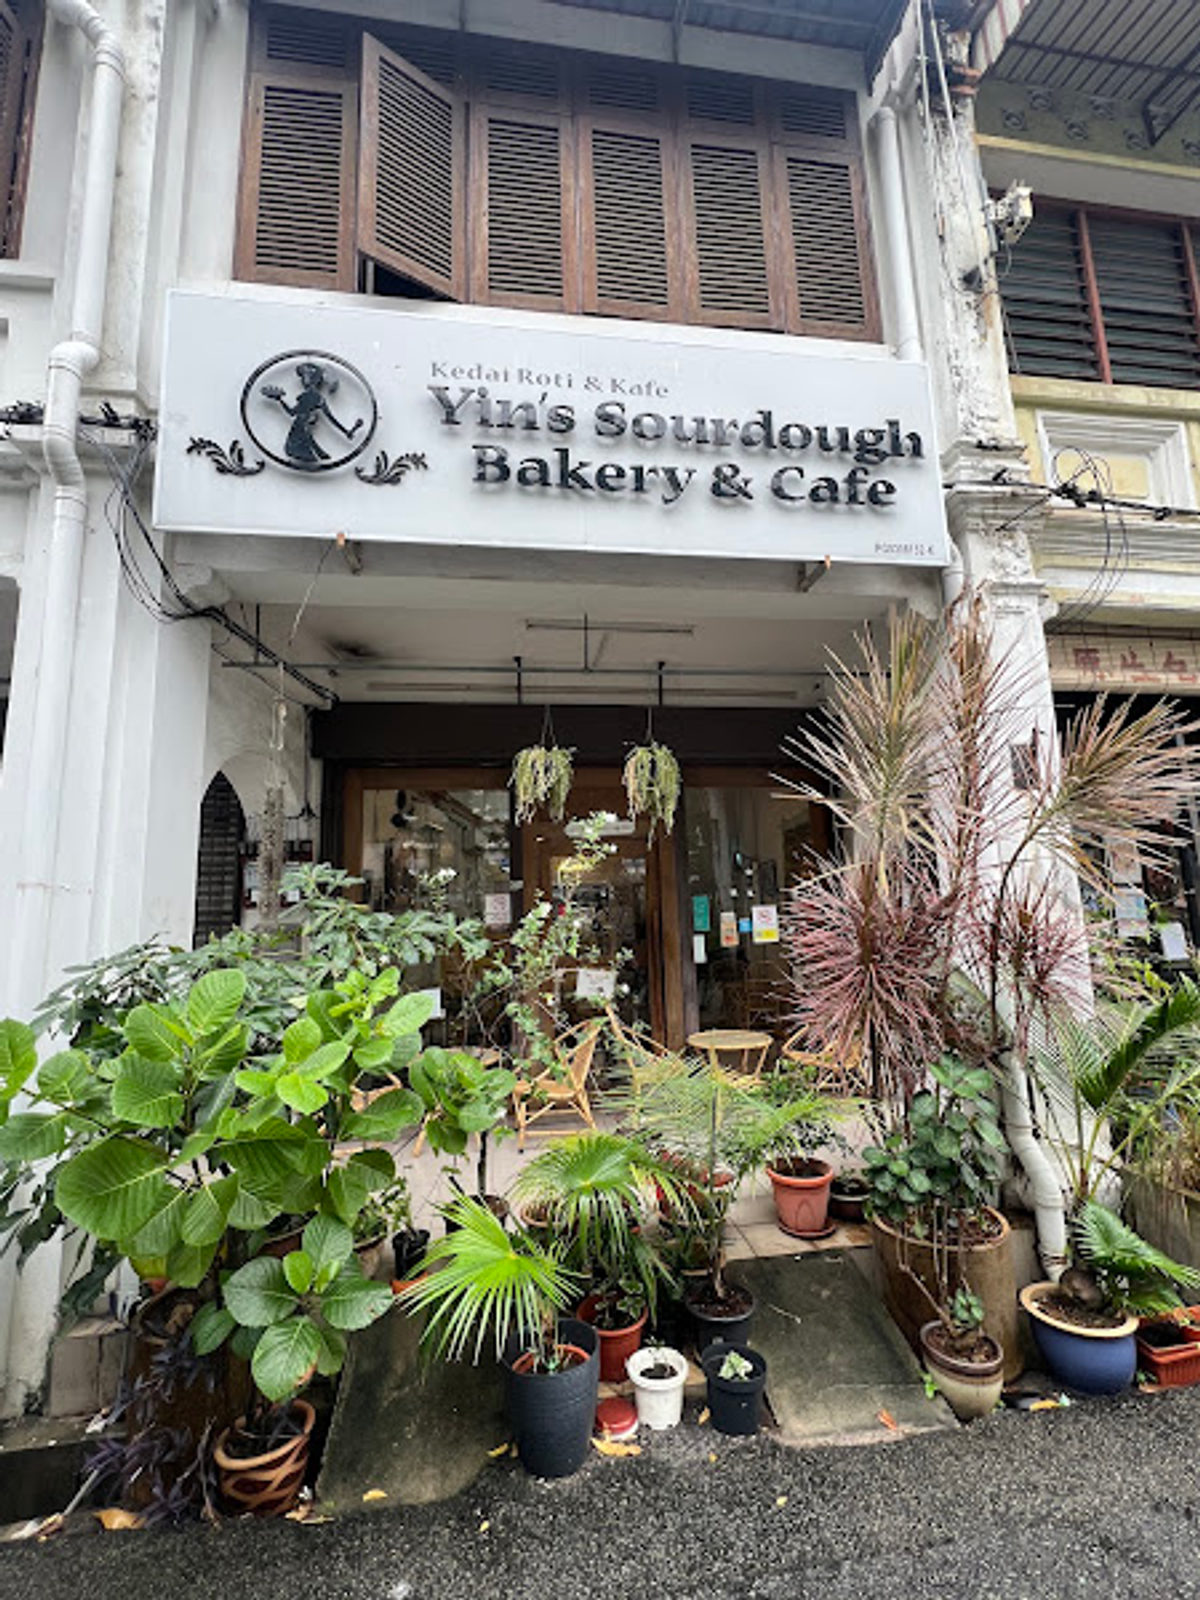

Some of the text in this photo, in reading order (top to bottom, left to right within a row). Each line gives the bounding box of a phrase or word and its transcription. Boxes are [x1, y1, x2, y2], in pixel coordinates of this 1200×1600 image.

[431, 362, 669, 397] Kedai Roti & Kafe
[427, 386, 924, 464] Yin's Sourdough
[472, 446, 897, 506] Bakery & Cafe
